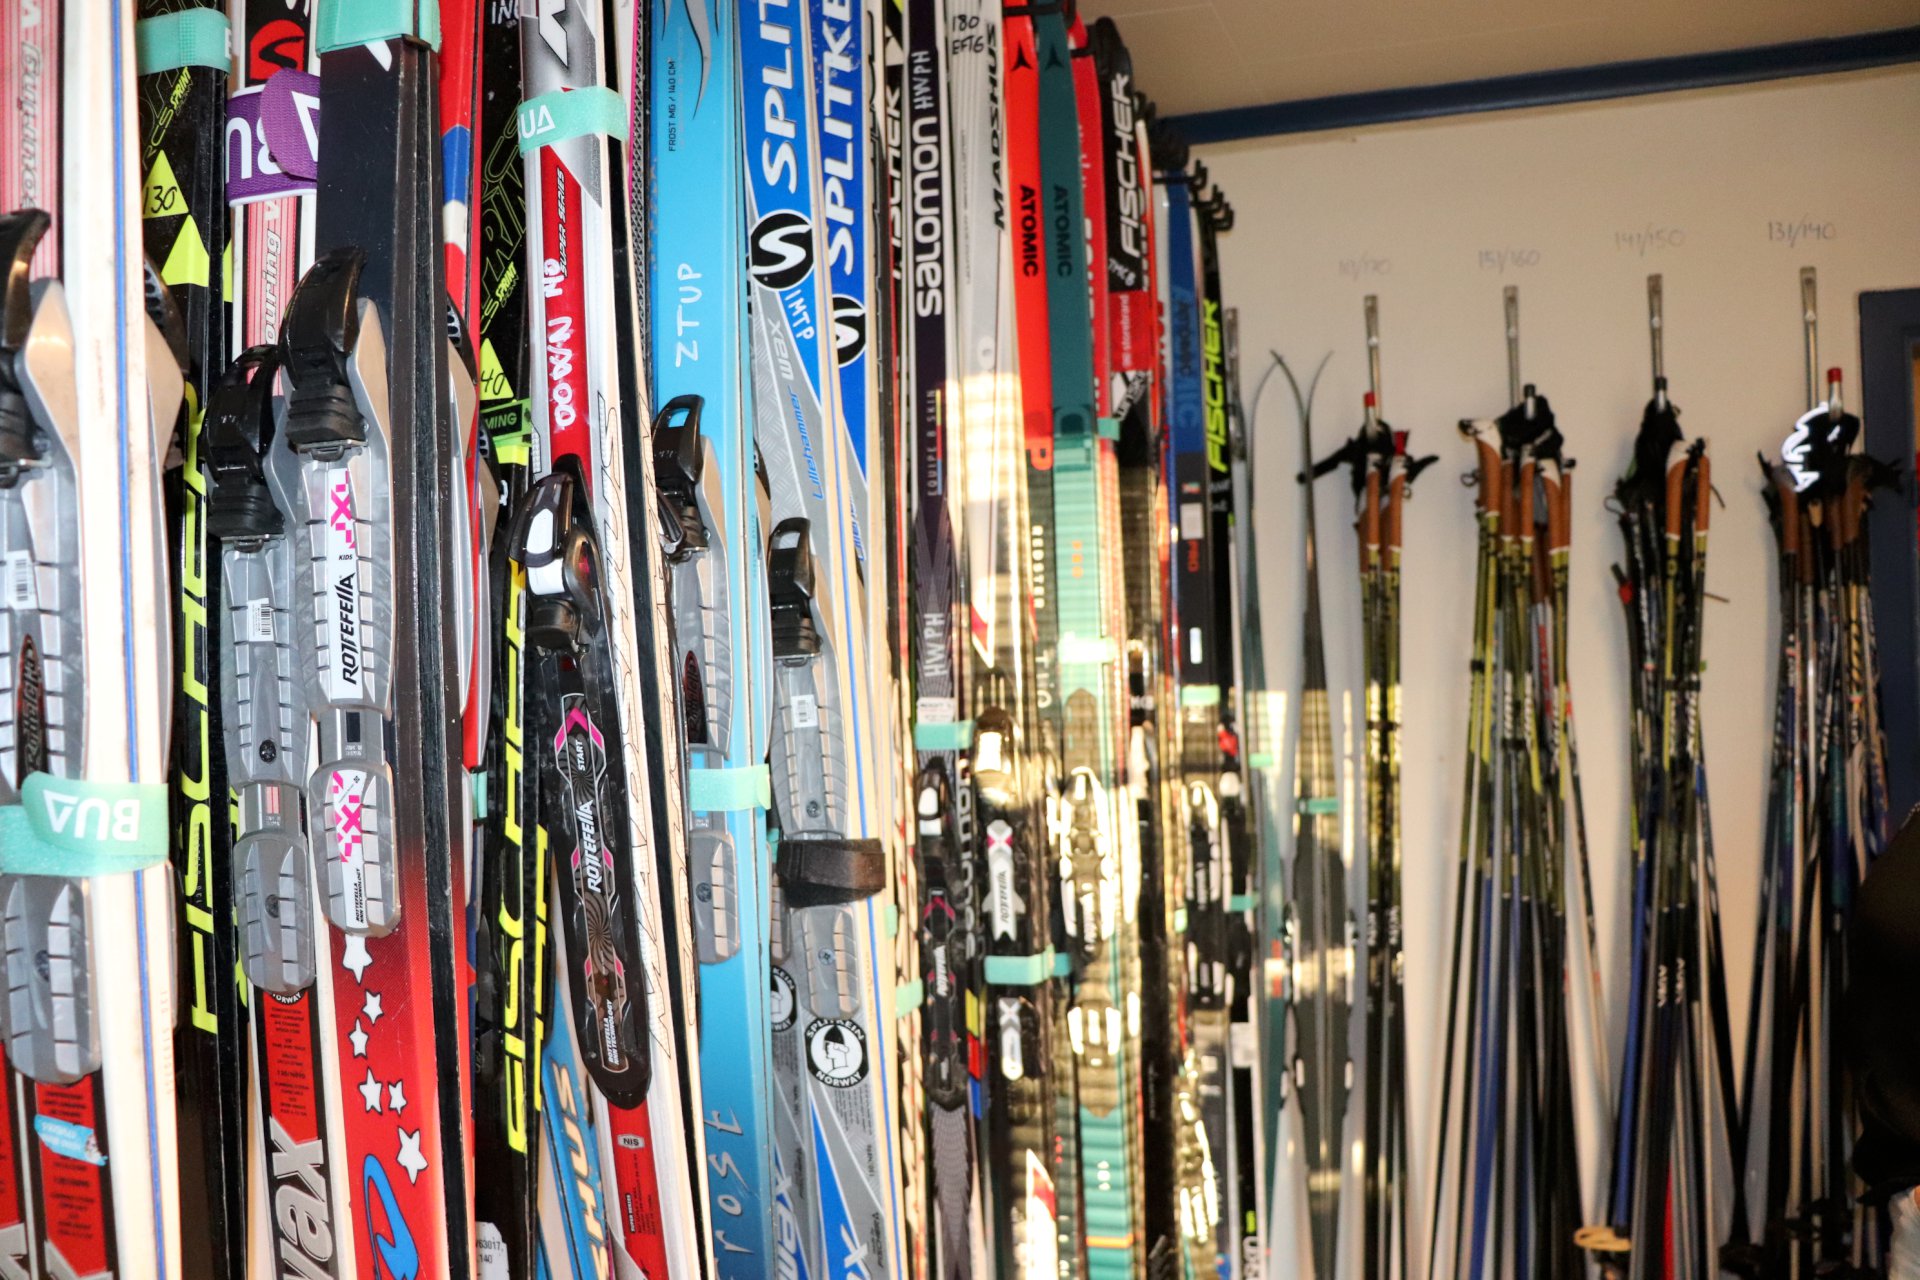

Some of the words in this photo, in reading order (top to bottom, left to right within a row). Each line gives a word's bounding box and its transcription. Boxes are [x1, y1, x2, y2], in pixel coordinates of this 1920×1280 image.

[951, 14, 980, 31] 180
[170, 66, 193, 110] SPRINT
[668, 61, 677, 76] CM
[668, 78, 677, 94] 140
[911, 51, 935, 110] HWPH
[518, 104, 556, 140] UA
[668, 104, 677, 119] MG
[668, 122, 677, 152] FROST
[986, 22, 1005, 230] MADSHUS
[1111, 73, 1140, 259] FISCHER
[556, 167, 566, 222] SERIES
[557, 222, 568, 278] SUPER
[1020, 185, 1039, 278] ATOMIC
[1053, 184, 1073, 279] ATOMIC
[264, 229, 281, 345] ouring
[494, 260, 517, 302] SPRINT
[674, 263, 704, 368] ZTUP
[784, 289, 817, 341] IMTP
[767, 317, 795, 381] wax
[925, 389, 936, 422] SKIN
[1203, 298, 1228, 474] FISCHER
[787, 384, 826, 501] Lillehammer
[926, 445, 937, 496] EQUIPE
[338, 554, 354, 562] KIDS
[1031, 525, 1045, 609] REDSTER
[922, 611, 946, 678] HWPH
[577, 739, 586, 772] START
[42, 788, 140, 843] BUA
[604, 1017, 614, 1066] ROTTEFELLA
[607, 999, 618, 1048] TECHNOLOGY
[814, 1070, 863, 1088] NORWAY
[622, 1137, 640, 1147] NIS
